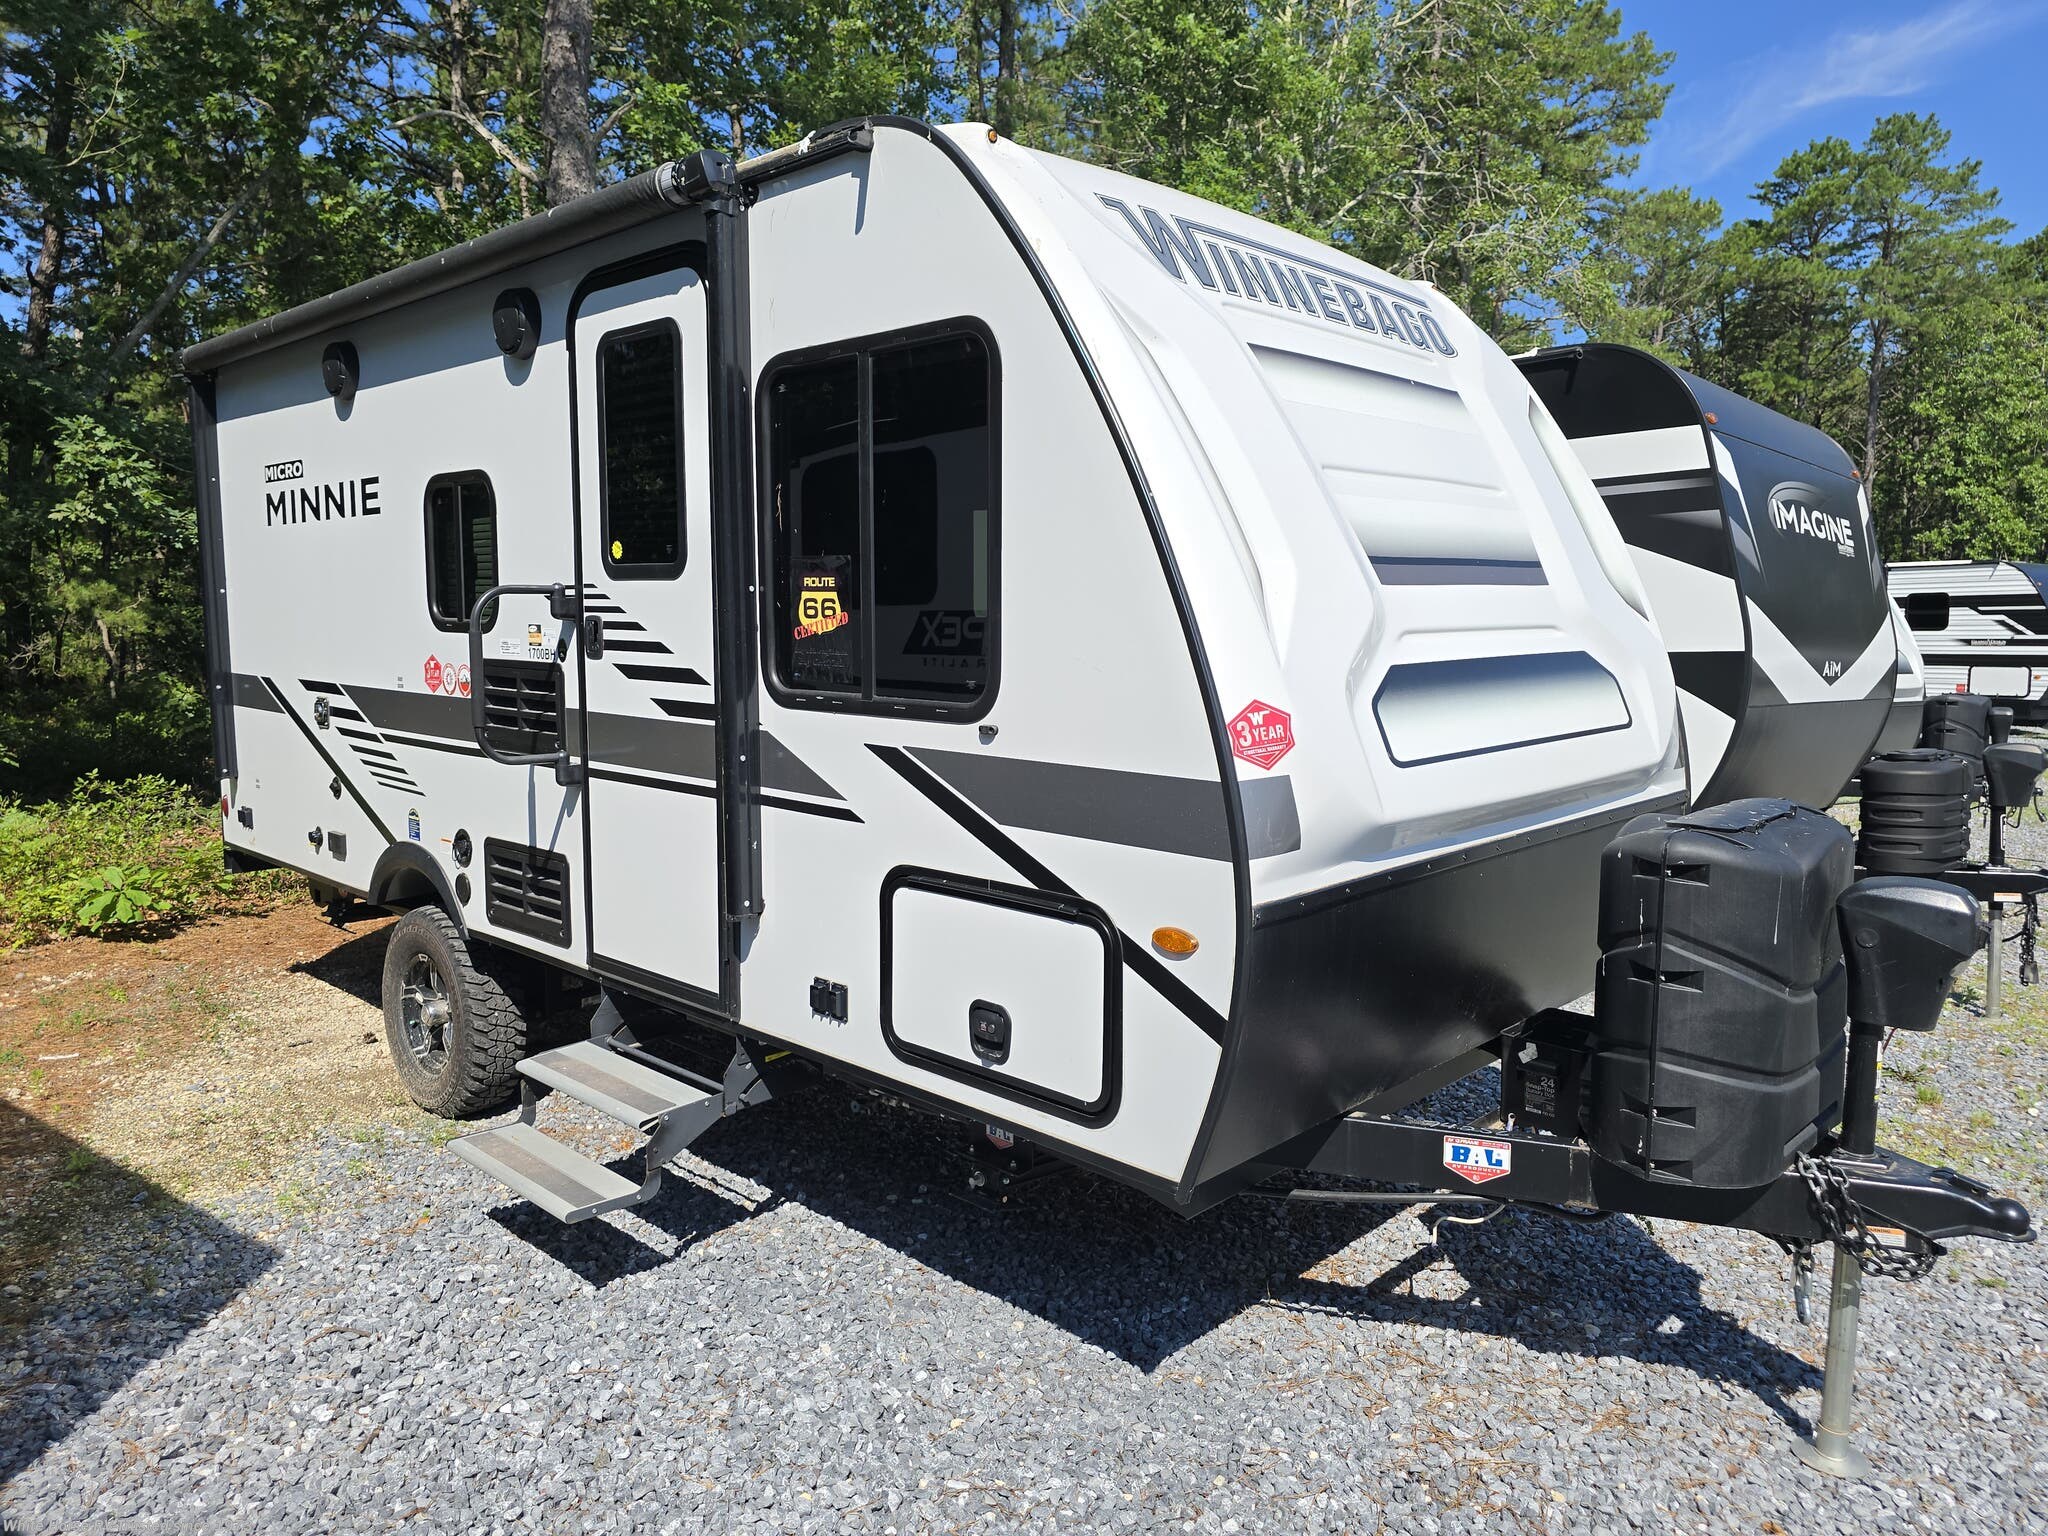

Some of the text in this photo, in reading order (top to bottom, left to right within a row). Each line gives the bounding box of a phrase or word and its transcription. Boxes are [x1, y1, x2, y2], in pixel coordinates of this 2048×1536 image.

[1093, 192, 1458, 360] WINNEBAGO
[265, 461, 303, 481] MICRO
[265, 476, 381, 527] MINNIE
[1772, 498, 1855, 547] IMAGINE
[803, 577, 836, 587] ROUTE
[803, 597, 837, 619] 66
[528, 648, 556, 661] 1700BH
[1236, 720, 1285, 747] 3 YEAR
[1540, 1076, 1555, 1088] 24
[1451, 1145, 1503, 1168] BAL
